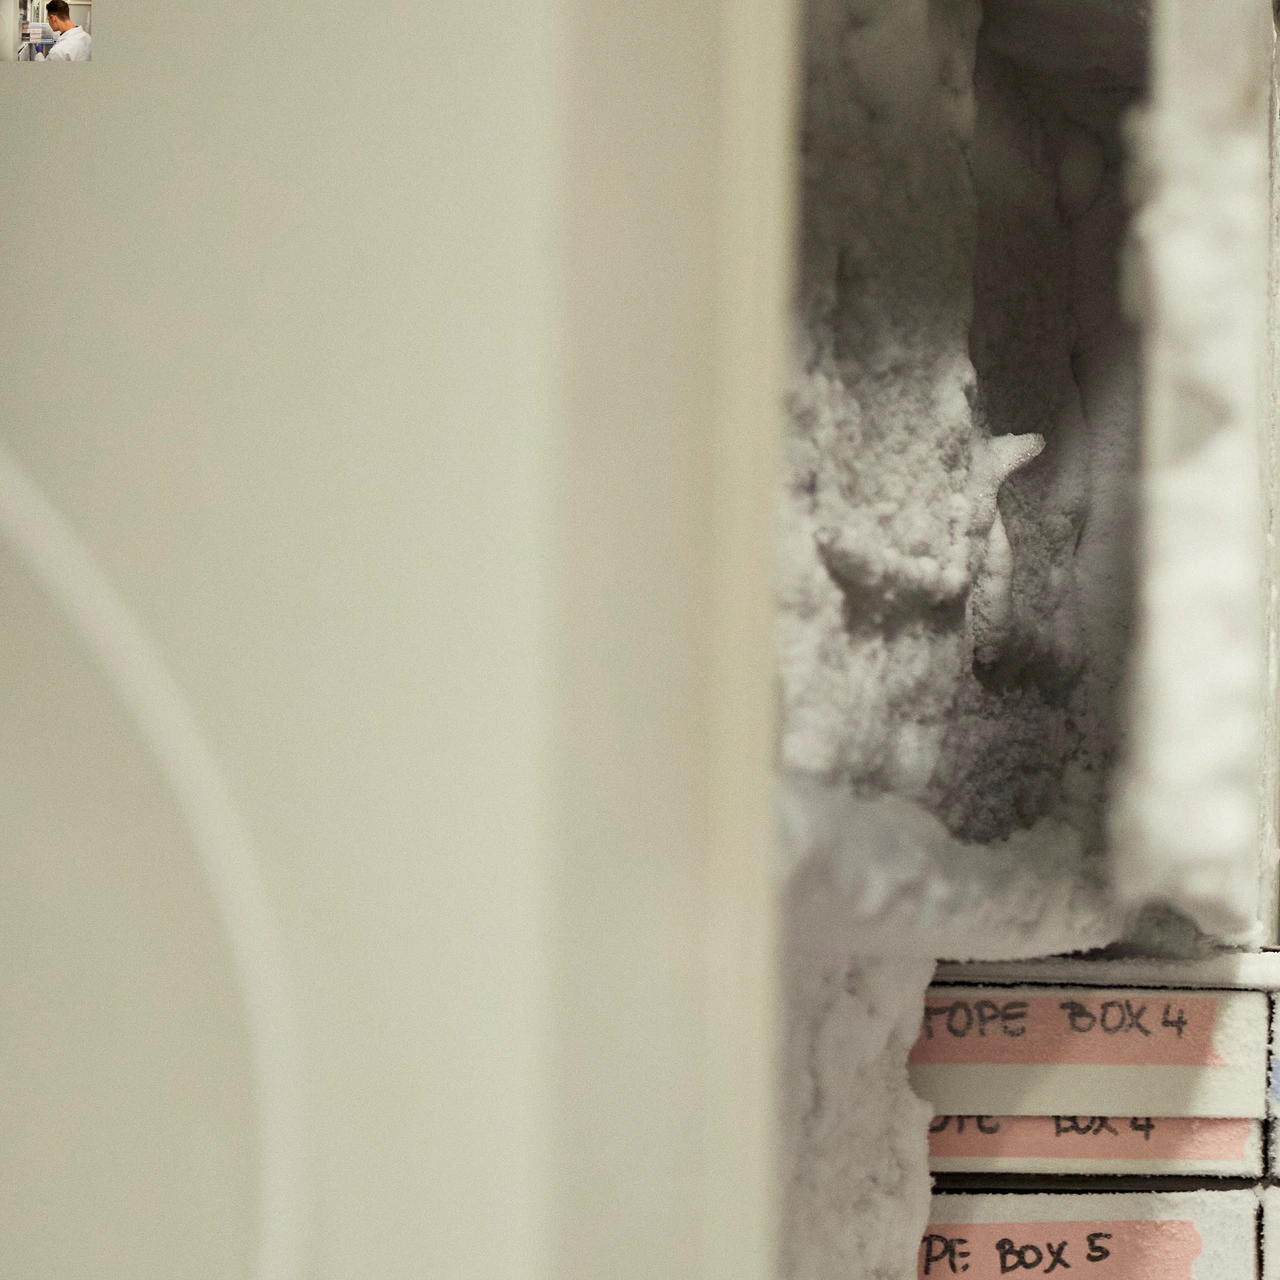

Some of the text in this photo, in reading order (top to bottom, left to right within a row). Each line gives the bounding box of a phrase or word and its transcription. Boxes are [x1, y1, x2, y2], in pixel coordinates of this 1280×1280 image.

[1060, 1000, 1151, 1037] BOX
[1161, 1004, 1187, 1038] 4
[995, 1237, 1071, 1275] BOX
[1085, 1232, 1113, 1263] 5
